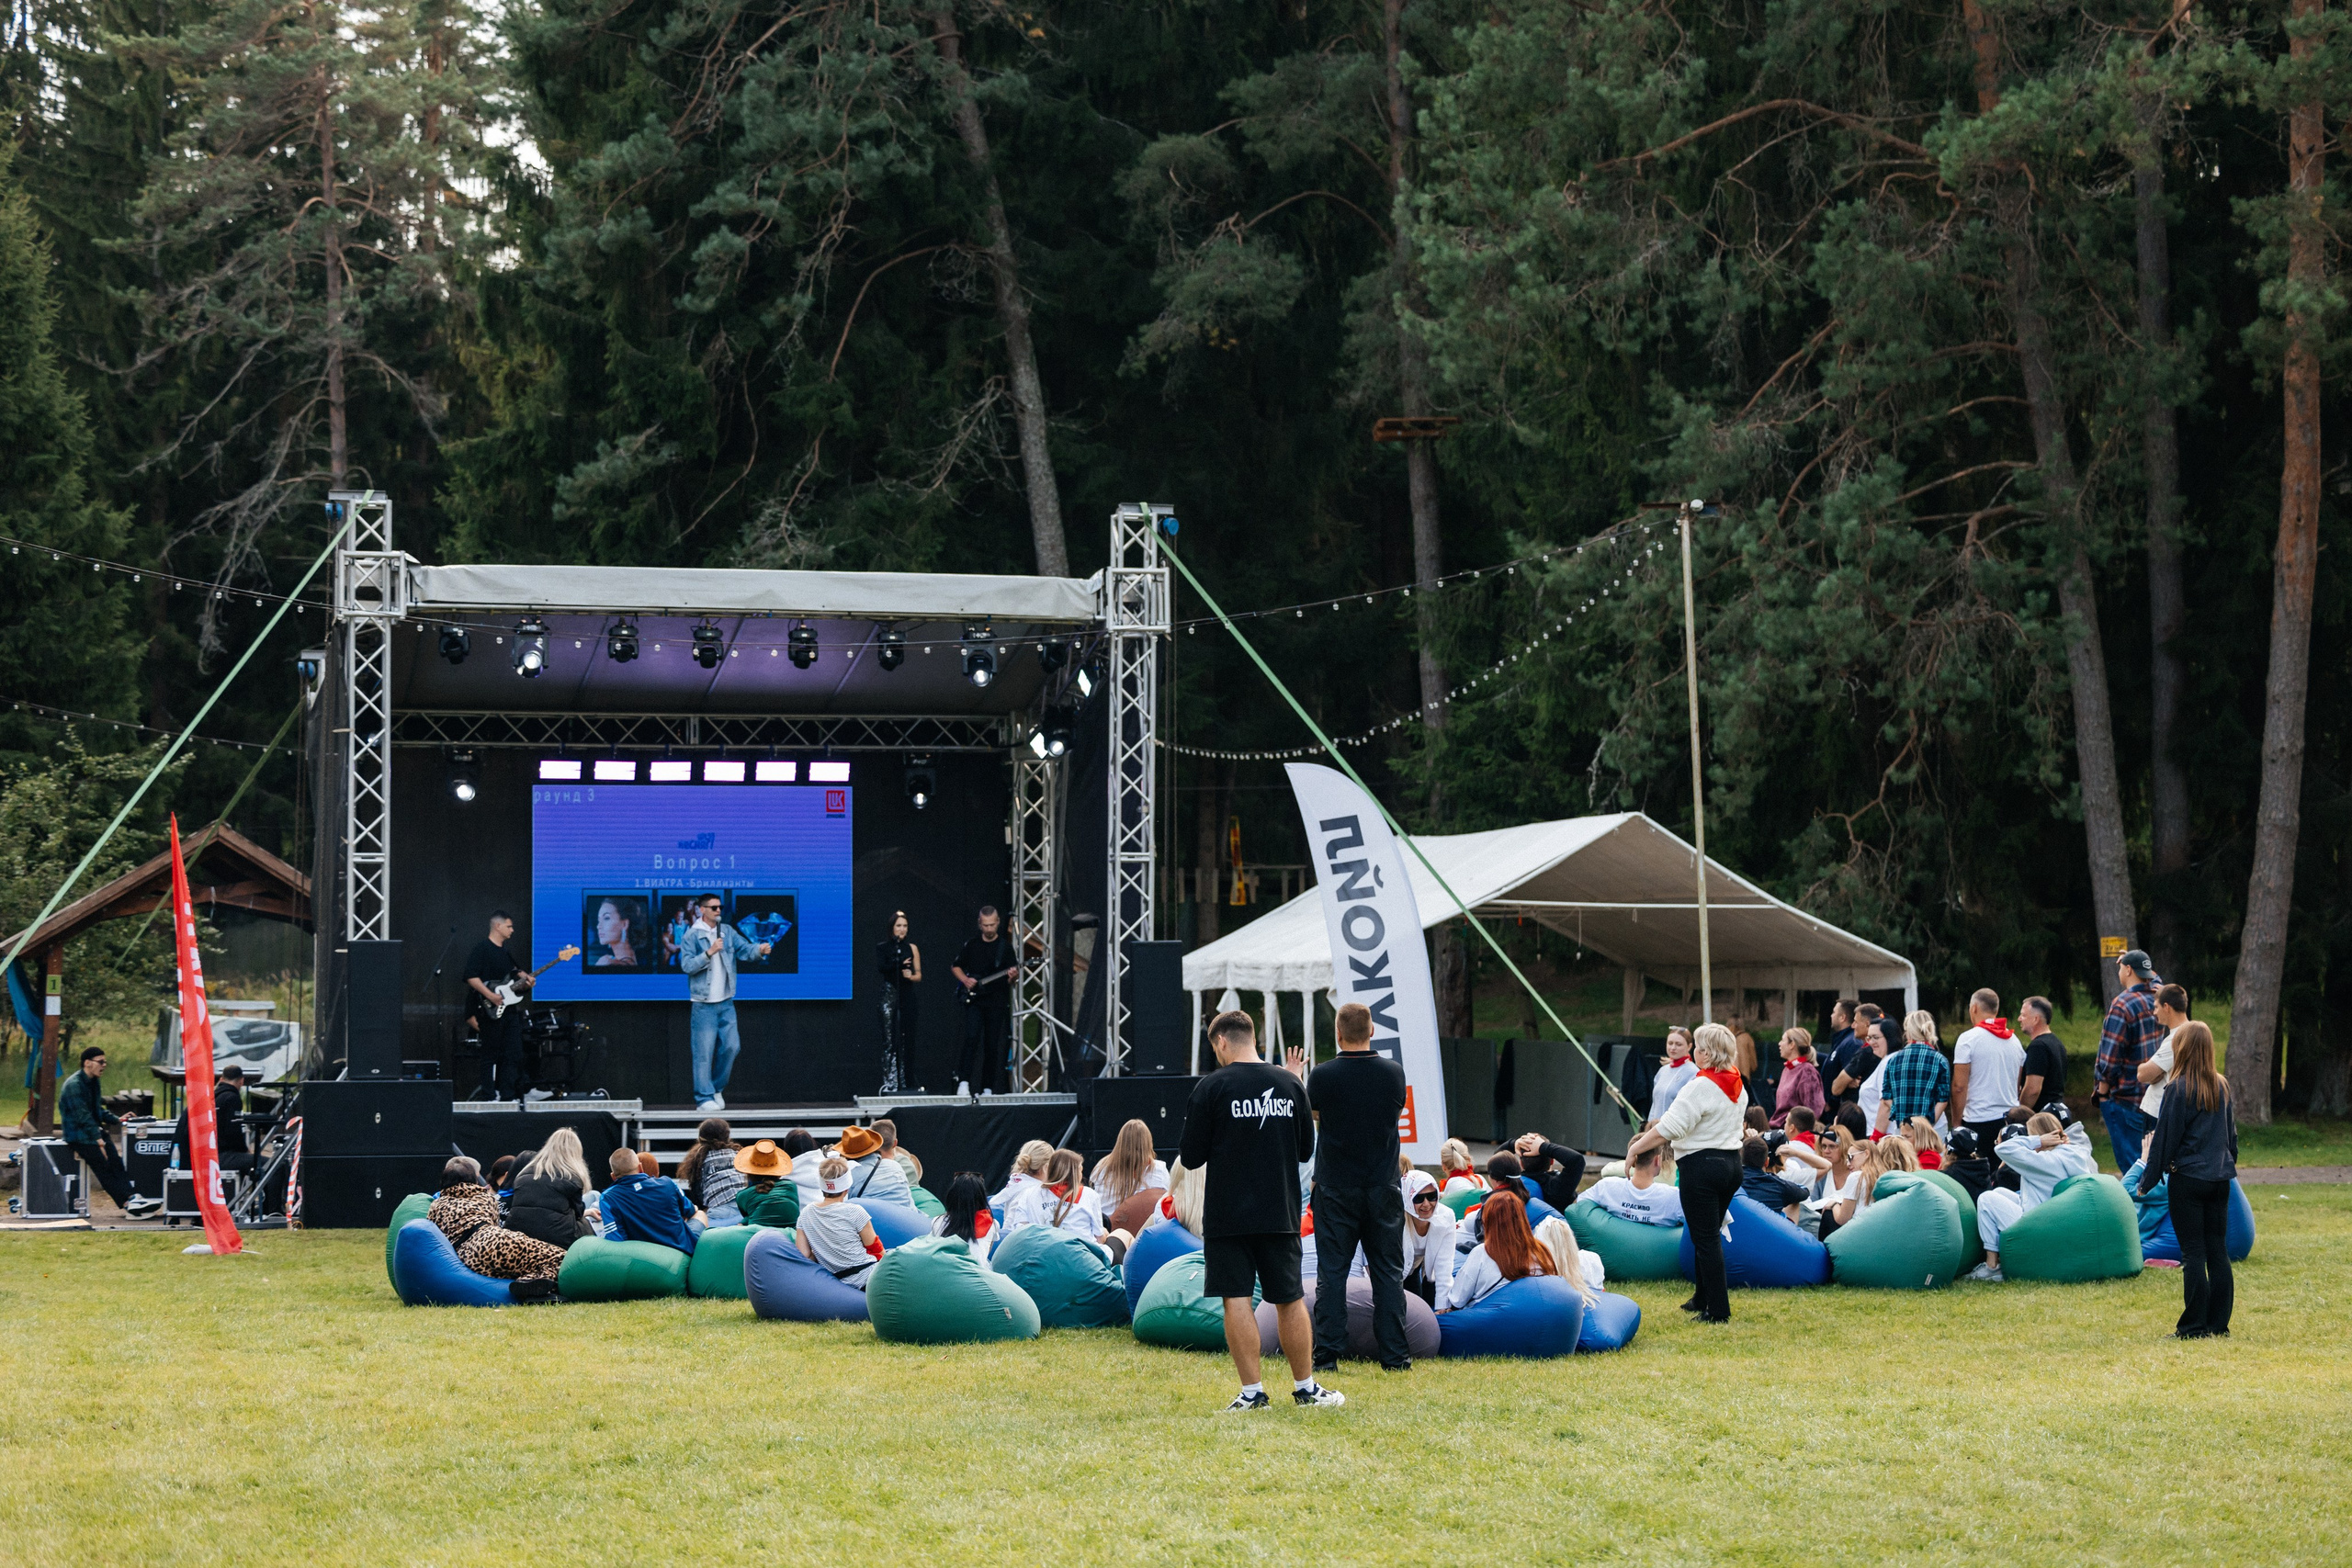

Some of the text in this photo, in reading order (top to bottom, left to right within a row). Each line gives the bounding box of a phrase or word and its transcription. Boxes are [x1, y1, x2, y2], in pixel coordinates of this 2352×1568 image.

[533, 788, 595, 805] раунд 3
[653, 854, 735, 873] Вопрос 1
[51, 979, 56, 990] 1
[1622, 1201, 1651, 1212] КРАСИВО
